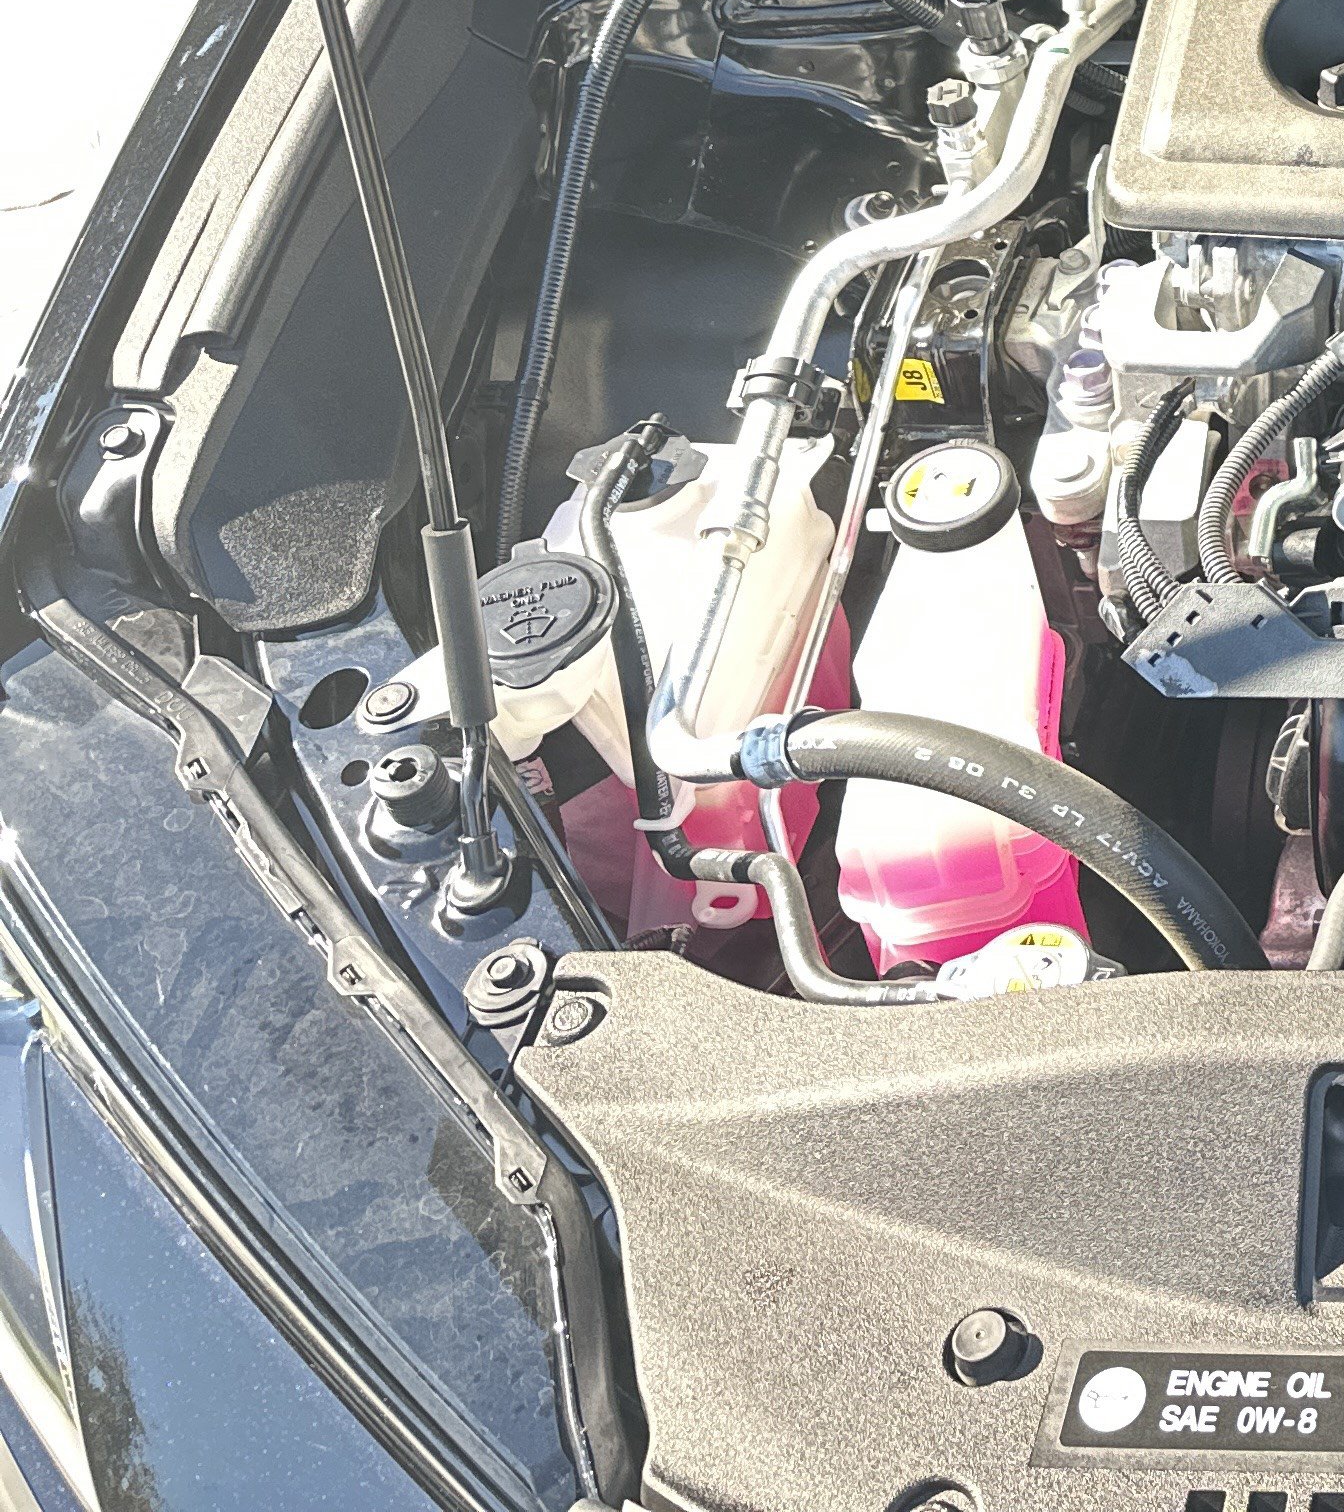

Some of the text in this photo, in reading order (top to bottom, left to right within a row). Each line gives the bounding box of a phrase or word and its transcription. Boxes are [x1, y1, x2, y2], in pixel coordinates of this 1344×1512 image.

[902, 369, 927, 390] J8
[540, 575, 578, 592] FLUID
[511, 592, 545, 608] ONLY
[913, 746, 932, 762] 2
[1001, 775, 1038, 801] 3J
[1050, 802, 1087, 829] LP
[1176, 896, 1231, 966] YOKOHAMA
[1165, 1369, 1332, 1399] ENGINE OIL
[1158, 1405, 1318, 1434] SAE 0W-8
